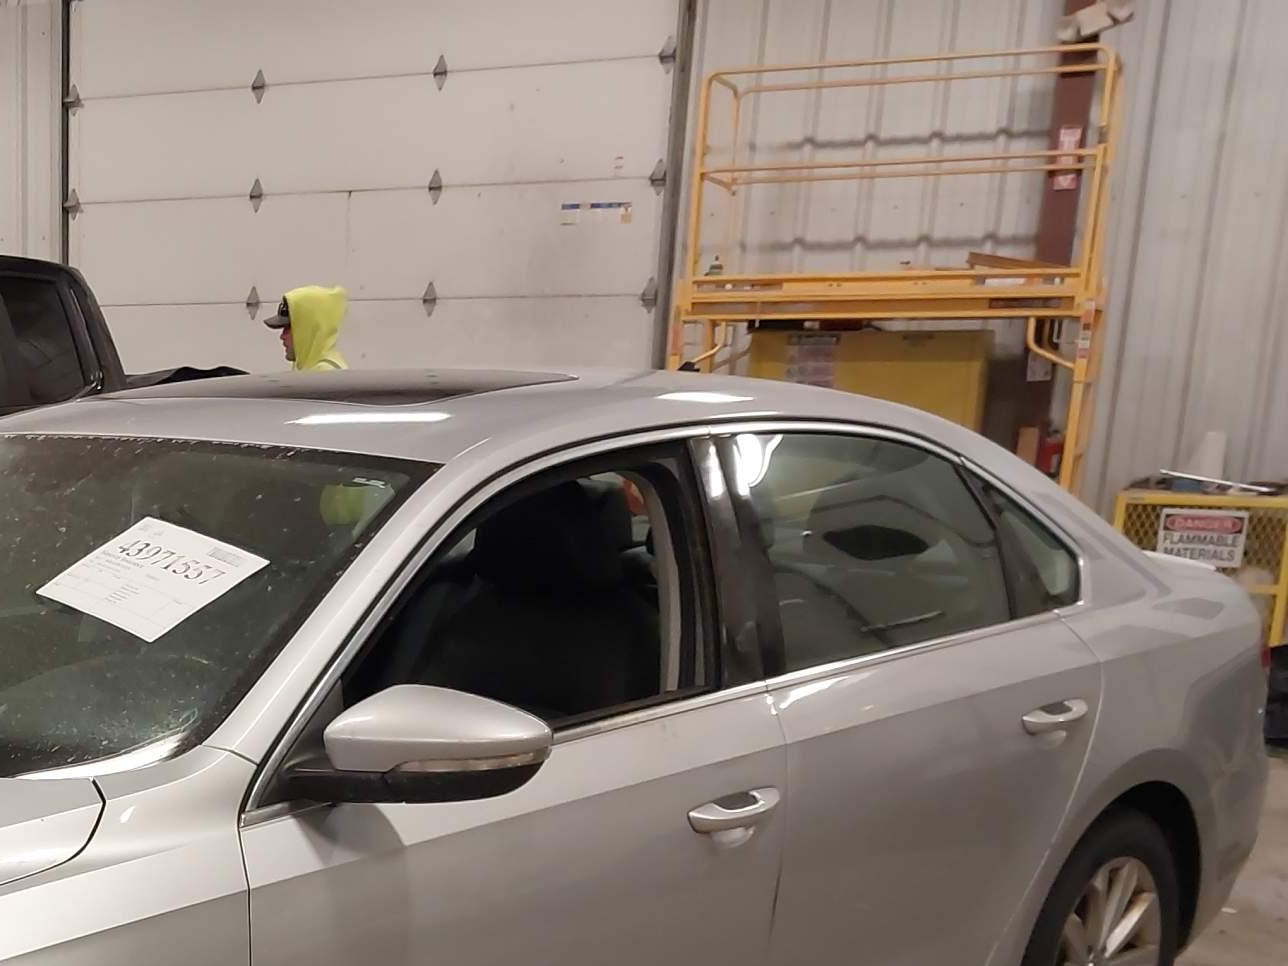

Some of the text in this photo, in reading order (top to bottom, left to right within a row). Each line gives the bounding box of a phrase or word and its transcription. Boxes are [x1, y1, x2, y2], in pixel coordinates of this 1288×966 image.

[1174, 517, 1233, 531] DANGER
[1163, 532, 1241, 548] FLAMMABLE
[118, 539, 227, 585] 43971557
[1163, 546, 1235, 562] MATERIALS
